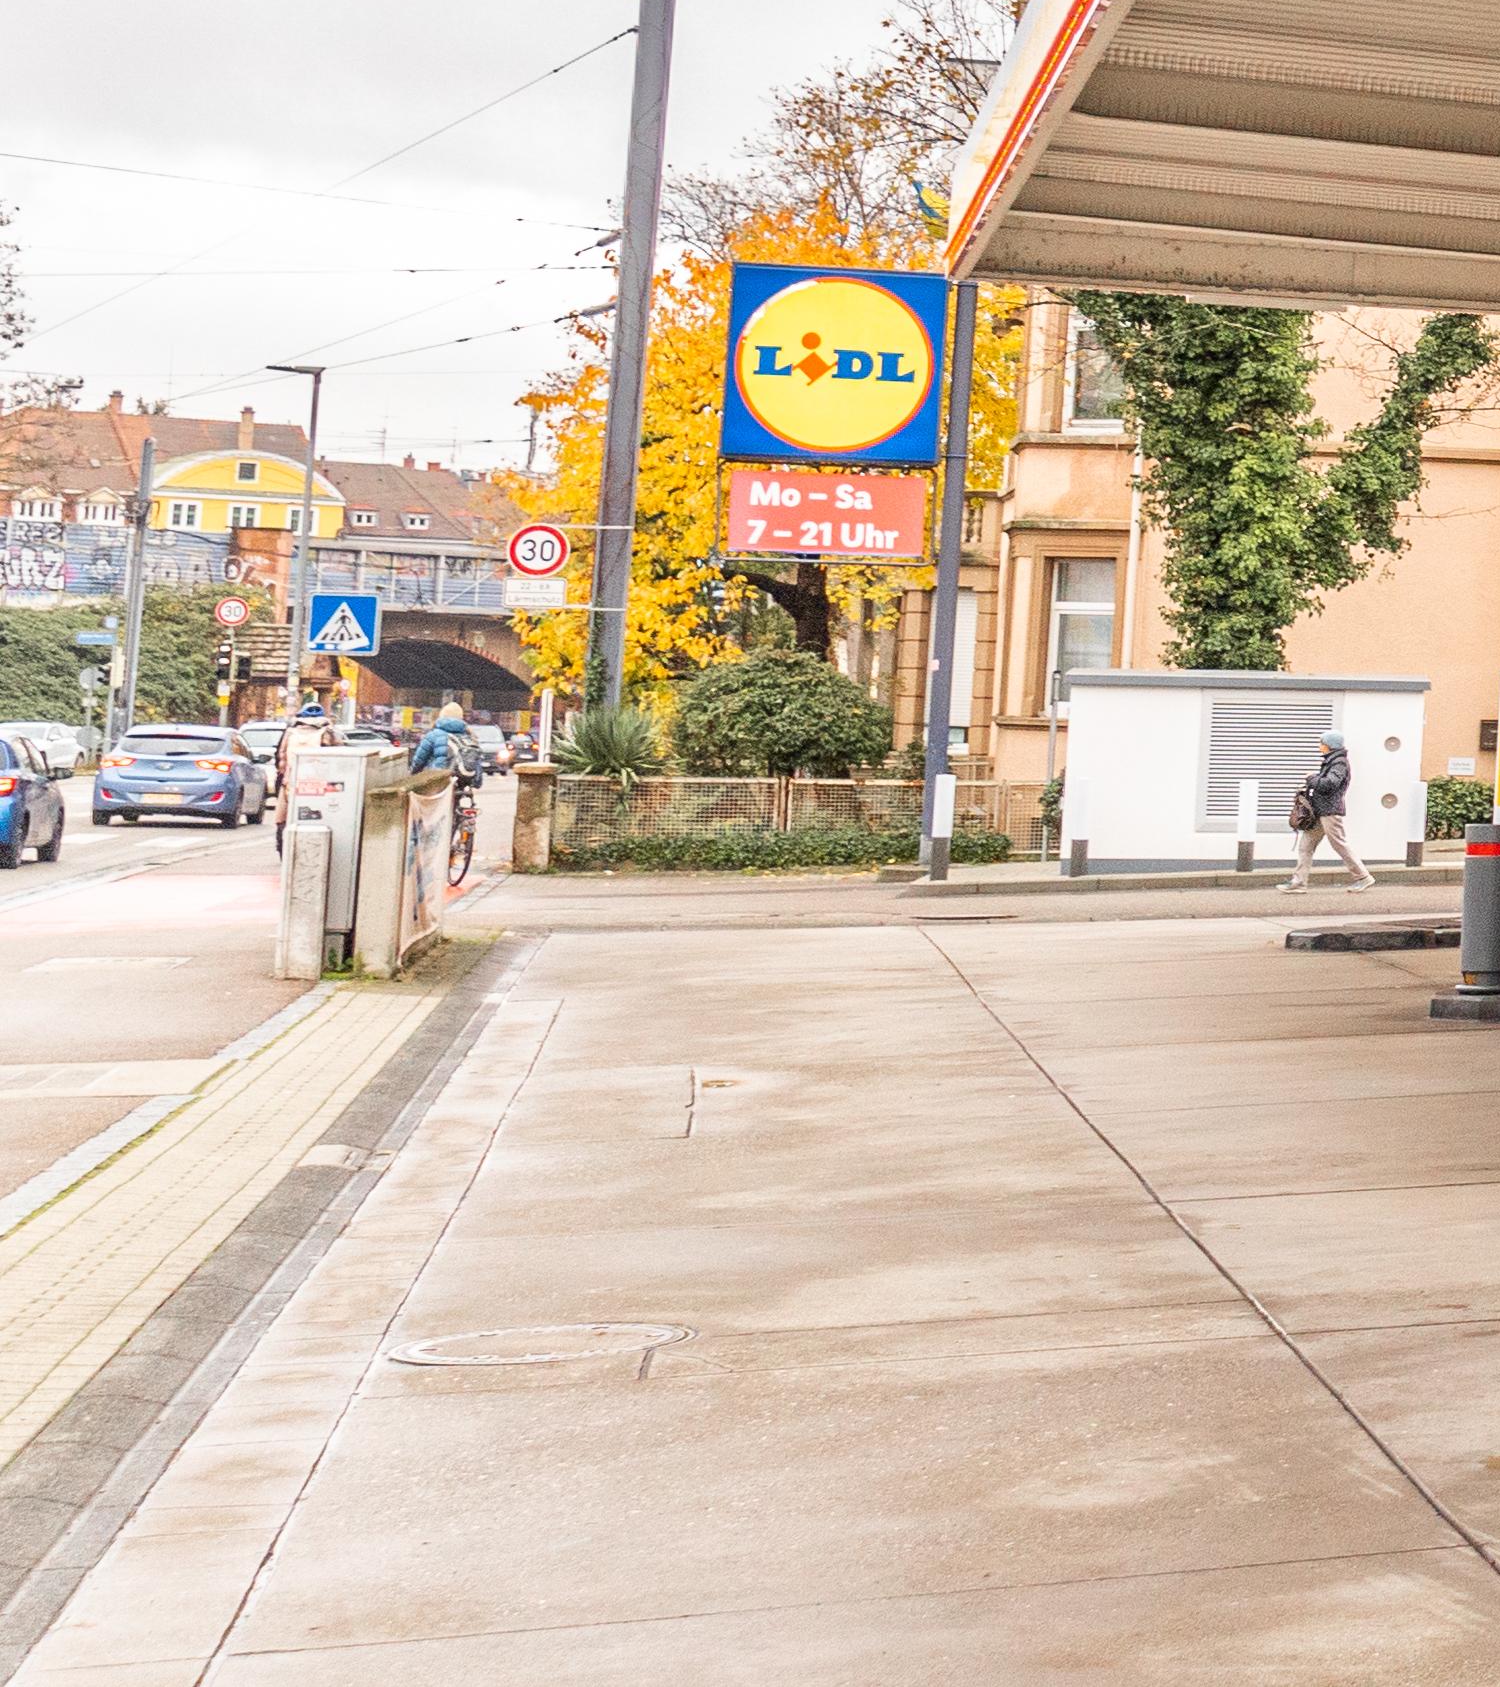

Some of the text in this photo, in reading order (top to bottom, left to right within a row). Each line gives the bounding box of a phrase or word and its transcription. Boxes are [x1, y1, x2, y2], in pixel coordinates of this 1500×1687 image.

[750, 481, 801, 508] Mo
[834, 484, 873, 510] Sa
[747, 520, 767, 544] 7
[800, 521, 832, 547] 21
[840, 523, 899, 550] Uhr
[522, 539, 555, 561] 30
[224, 605, 242, 617] 30
